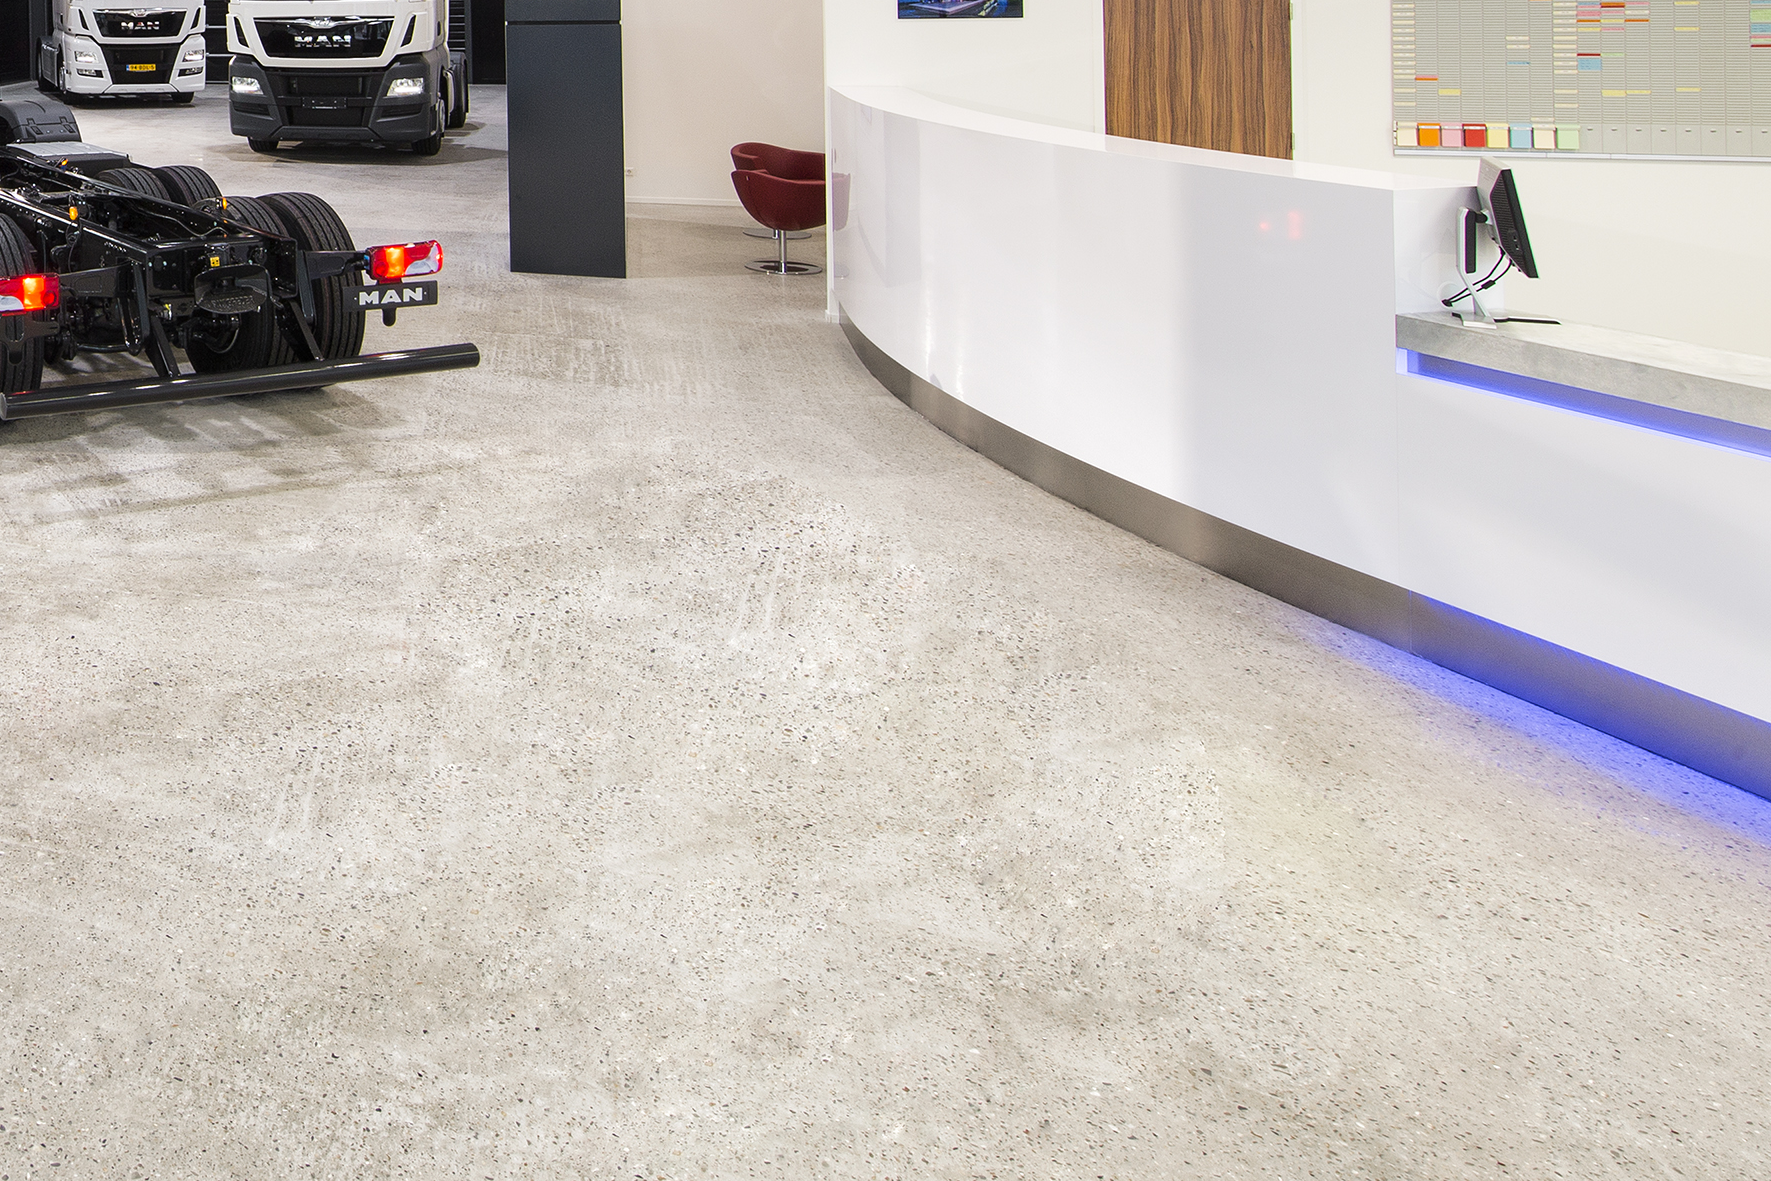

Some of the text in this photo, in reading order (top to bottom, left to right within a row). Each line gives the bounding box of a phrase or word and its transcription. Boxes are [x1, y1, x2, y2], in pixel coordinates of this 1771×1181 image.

[121, 21, 159, 30] MAN
[294, 35, 351, 47] MAN
[359, 287, 423, 306] MAN
